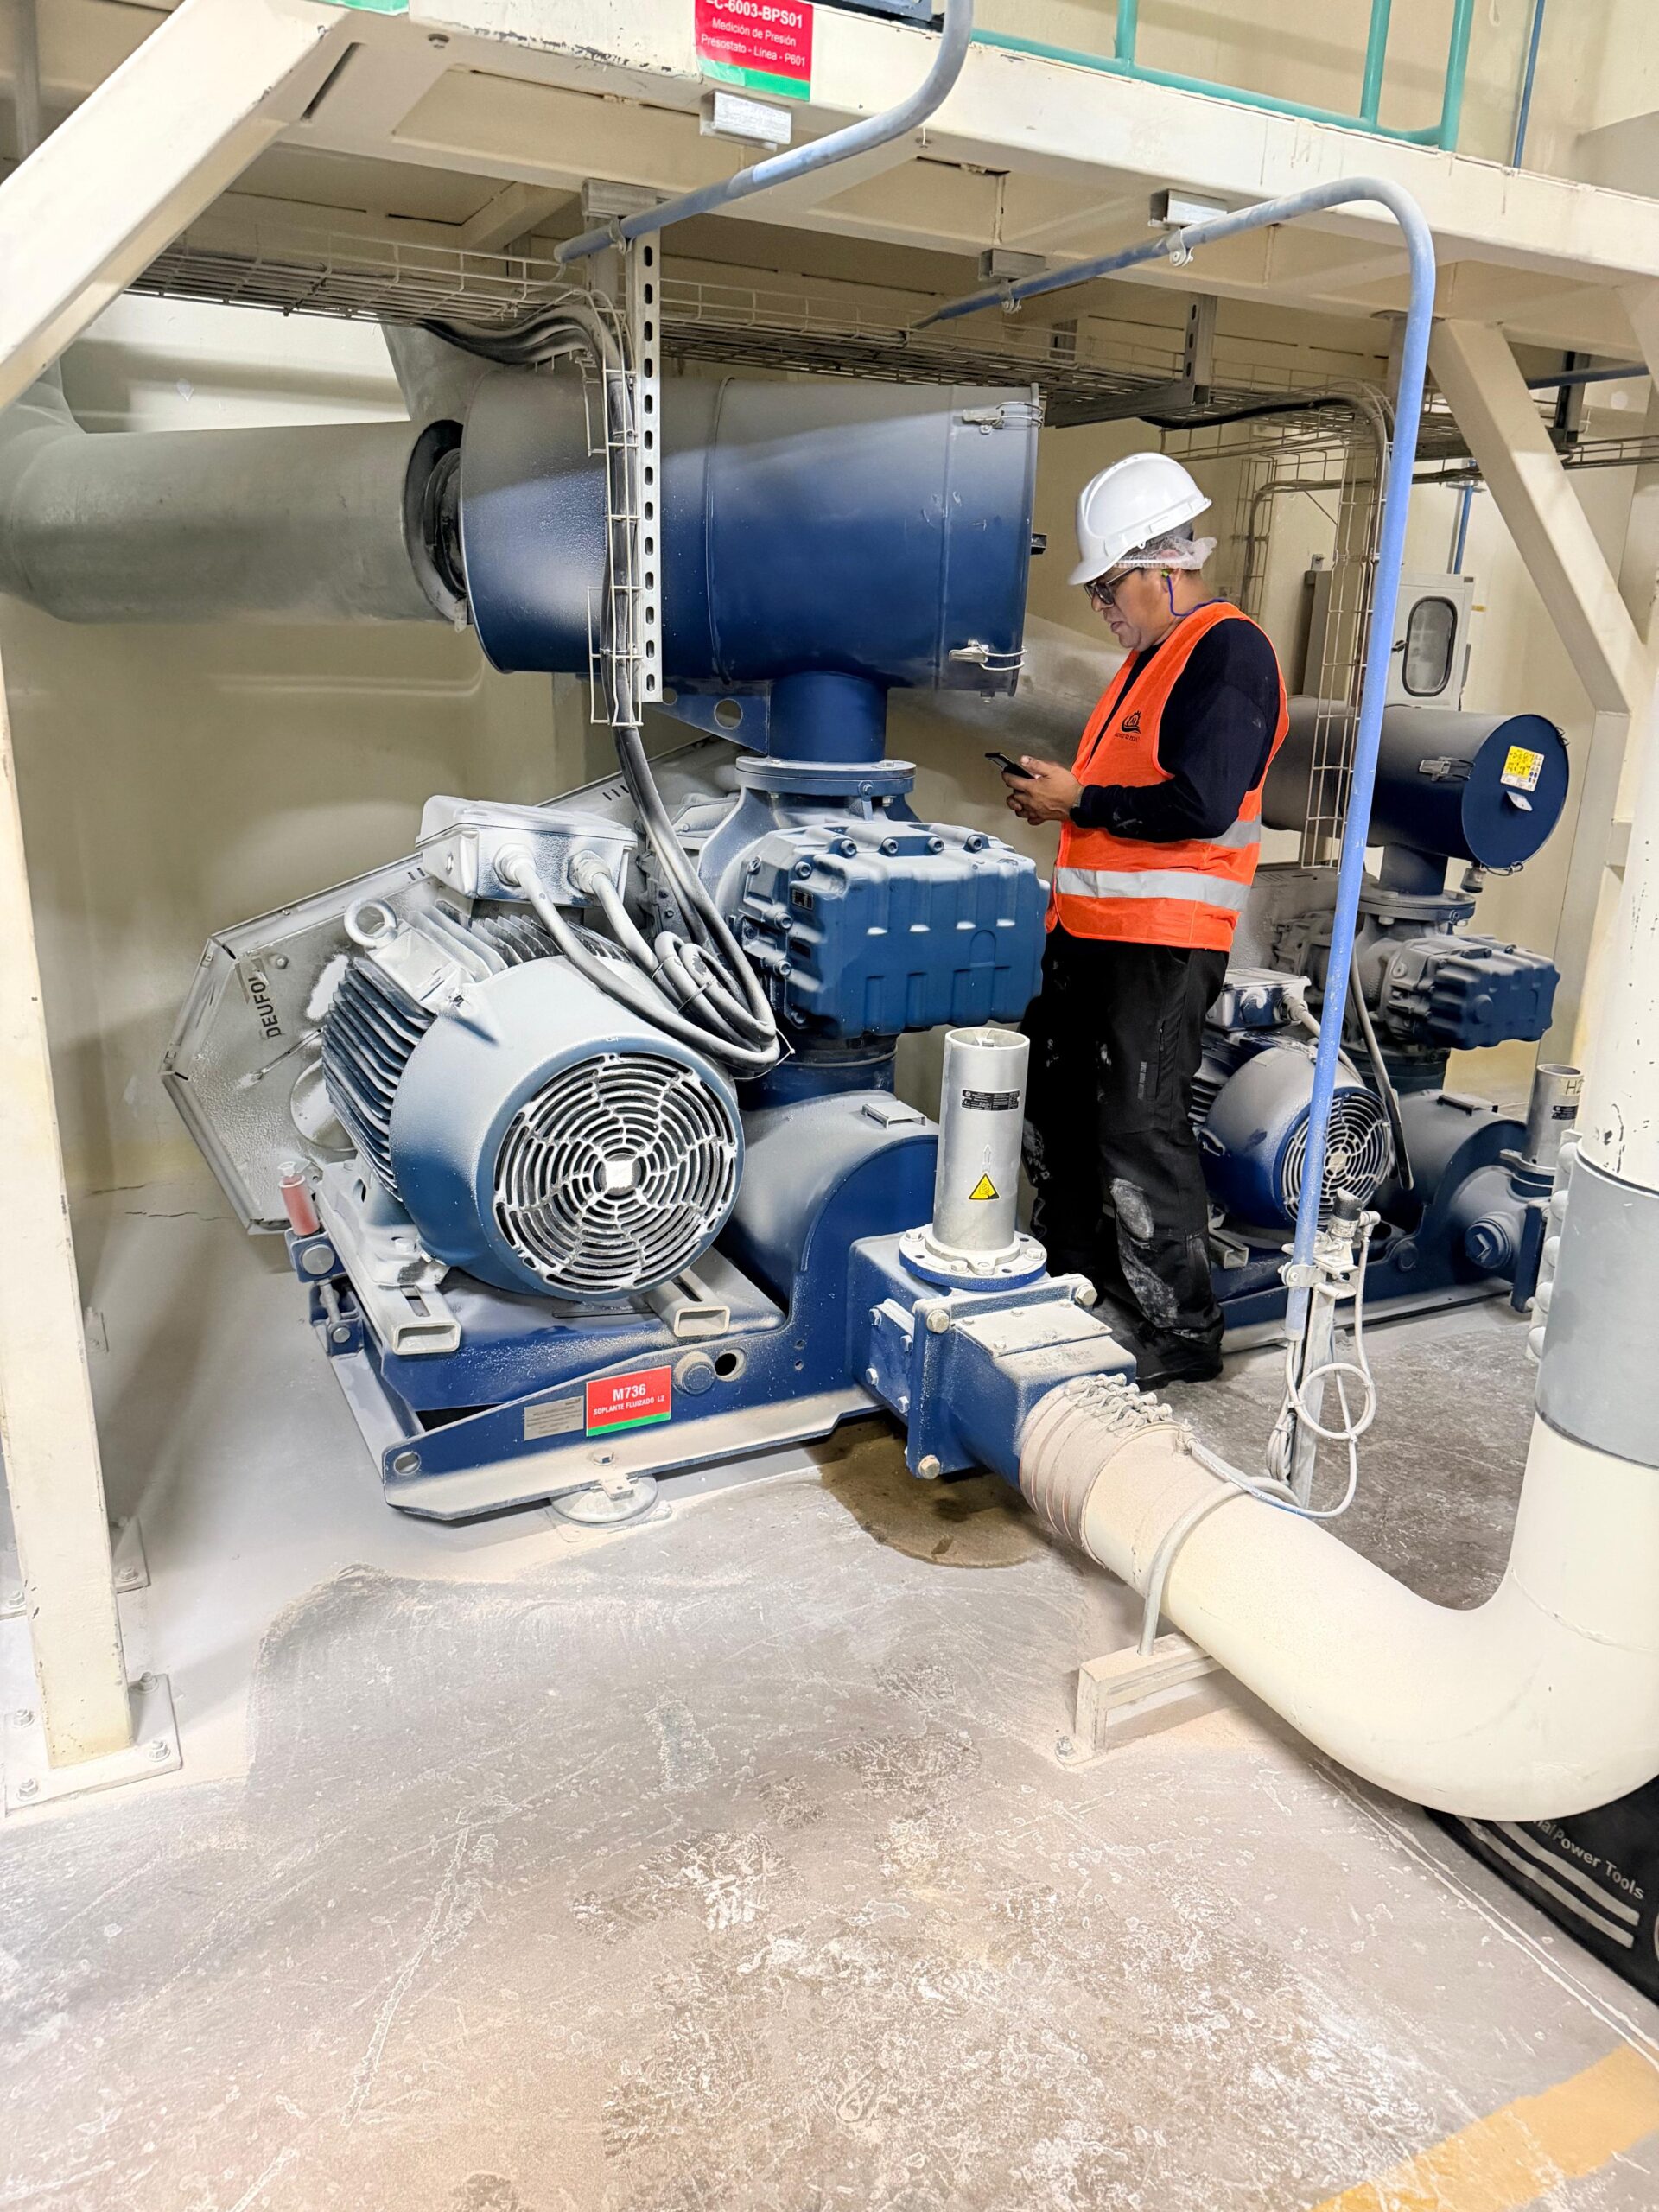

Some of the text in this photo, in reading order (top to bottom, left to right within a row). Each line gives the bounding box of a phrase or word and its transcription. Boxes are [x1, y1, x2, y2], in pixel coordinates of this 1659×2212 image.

[712, 17, 797, 47] Medición de Presión
[701, 34, 747, 54] Presostato
[785, 52, 805, 67] P601
[613, 1383, 646, 1402] M736
[593, 1403, 625, 1416] SOPLANTE
[1552, 1827, 1601, 1867] Power
[1605, 1860, 1644, 1900] Tools
